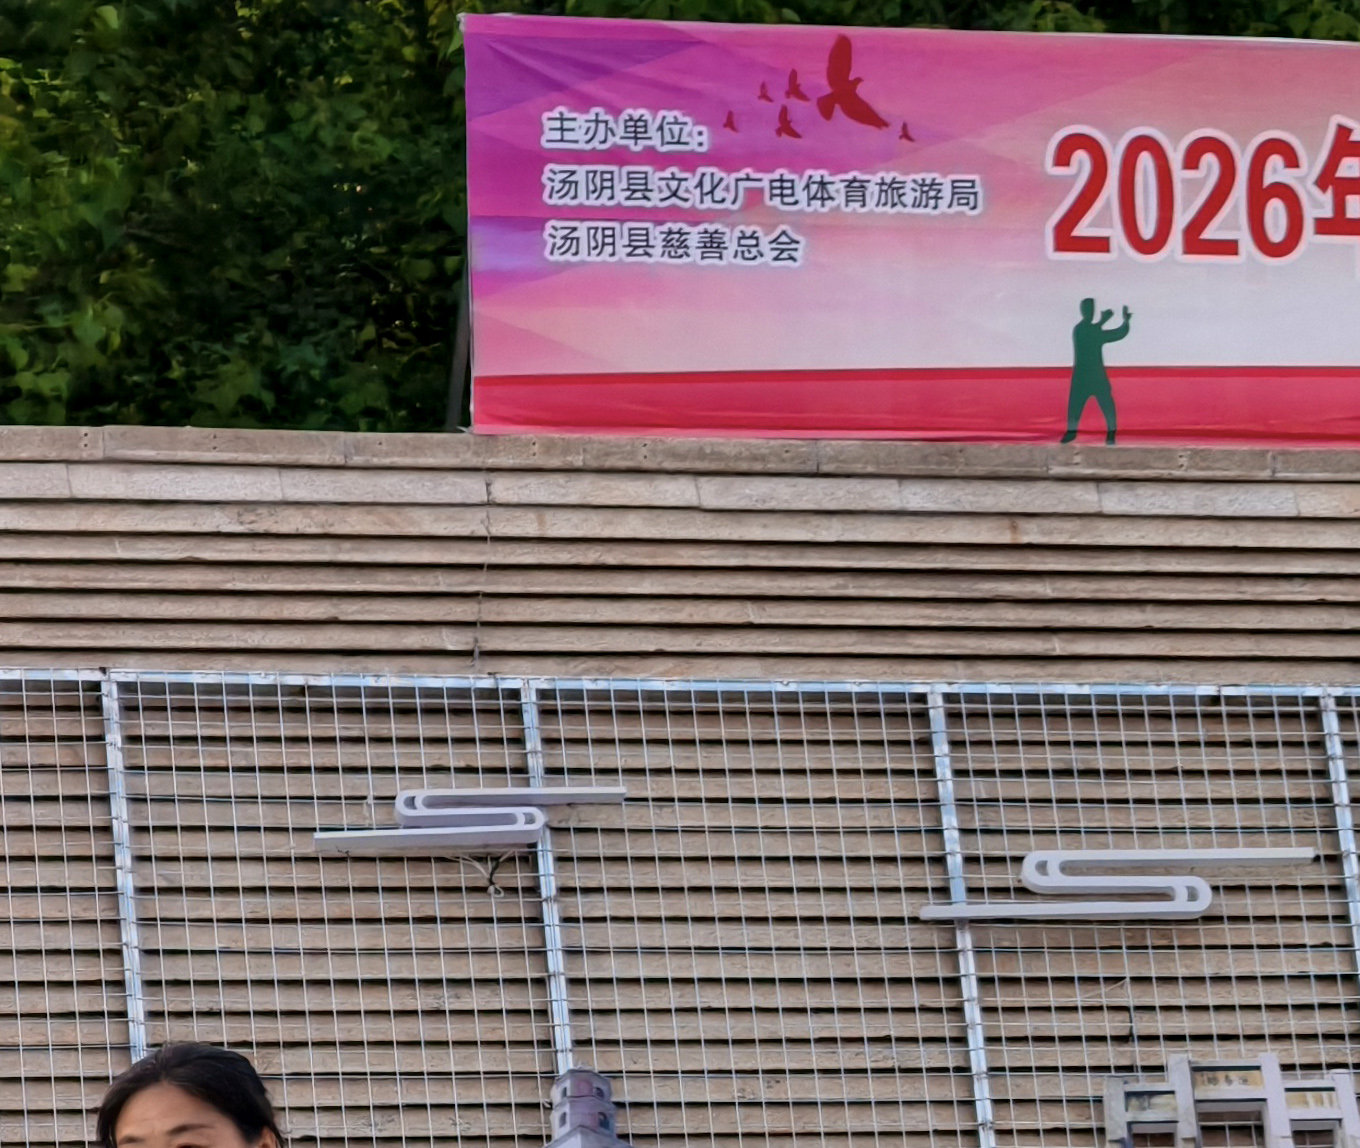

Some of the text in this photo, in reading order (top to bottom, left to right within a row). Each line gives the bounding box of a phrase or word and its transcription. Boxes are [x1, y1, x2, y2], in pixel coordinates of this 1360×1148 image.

[545, 169, 980, 212] 汤阴县文化广电体育旅游局
[546, 226, 802, 263] 汤阴县慈善总会
